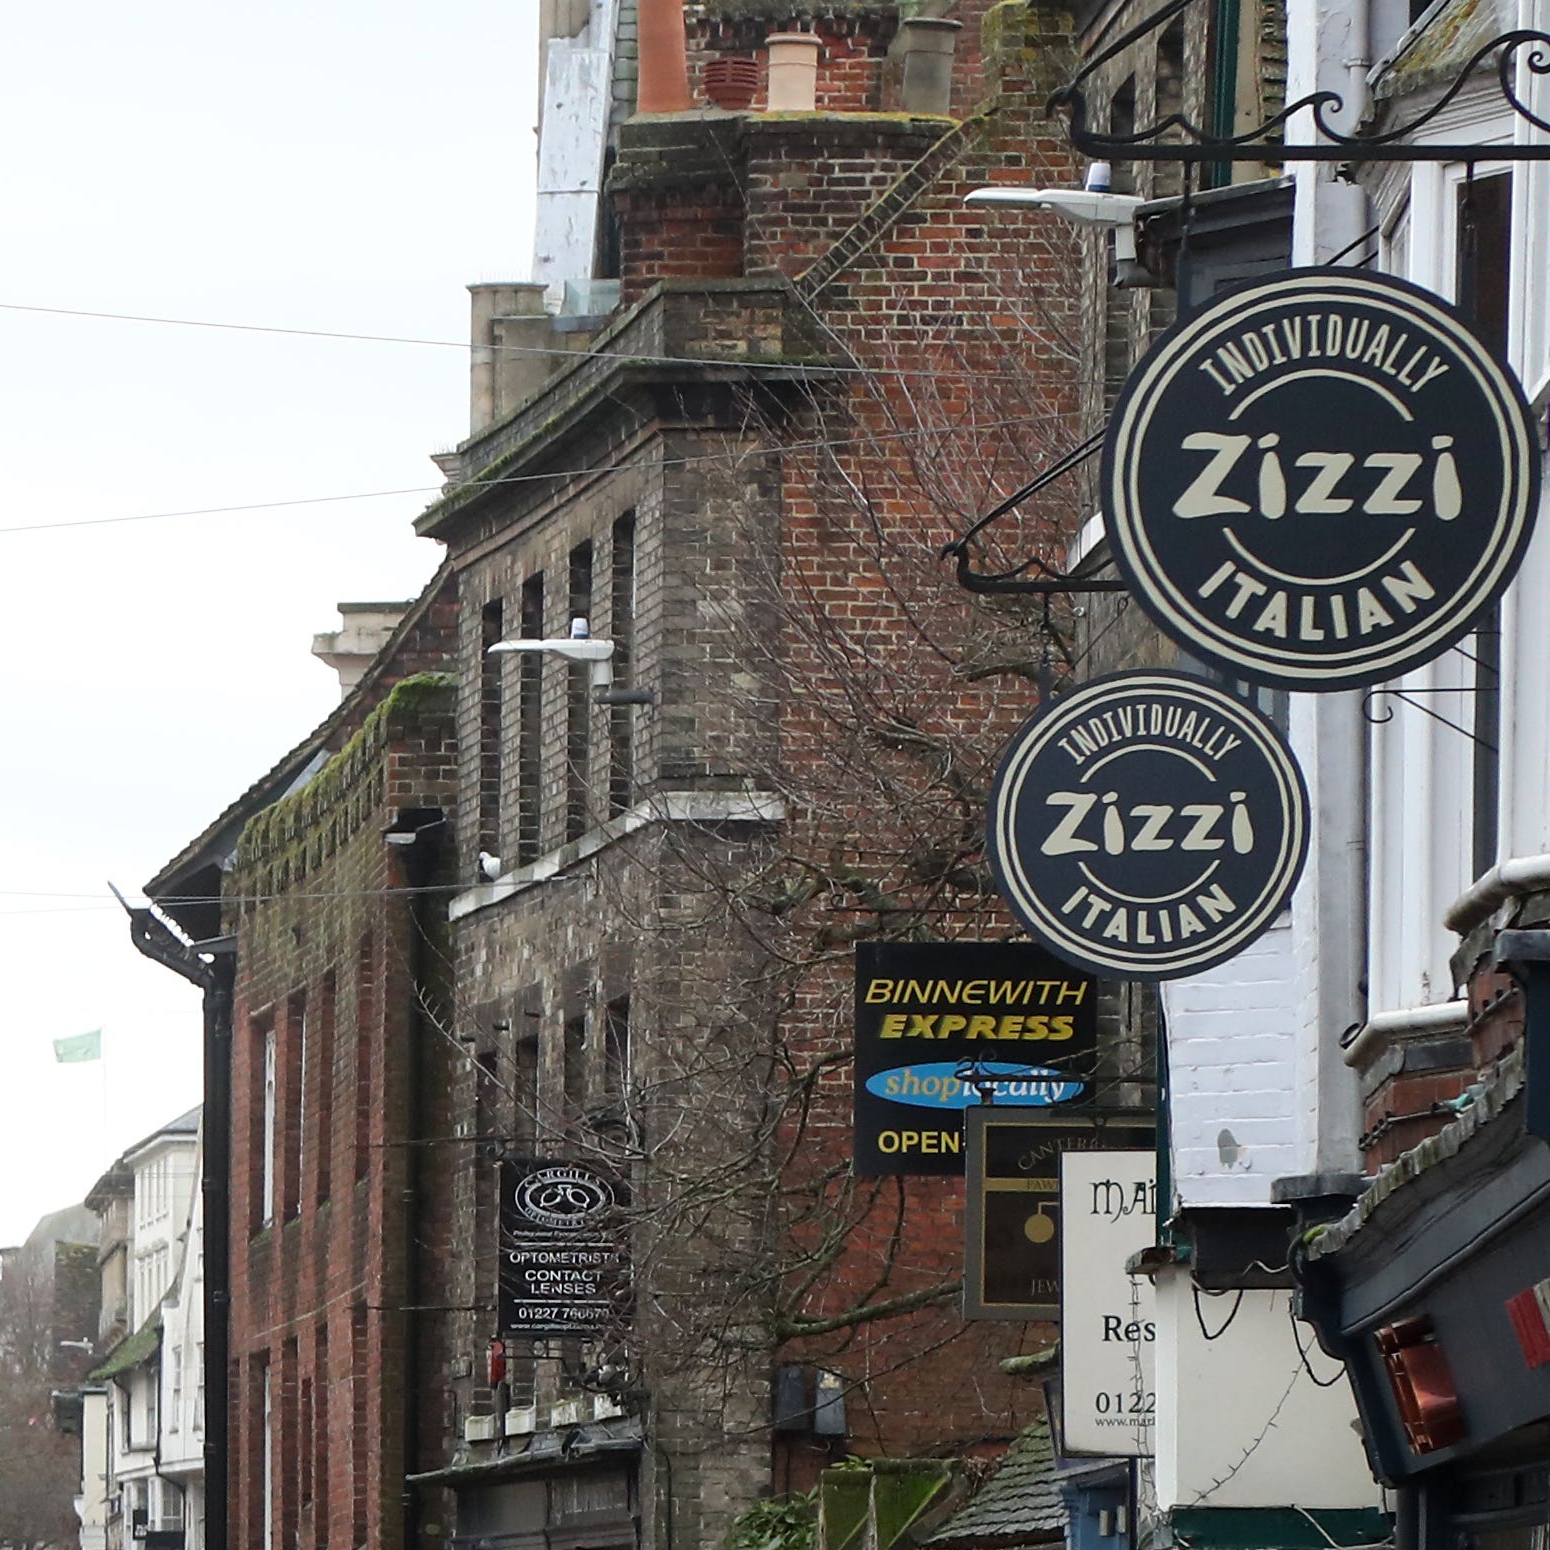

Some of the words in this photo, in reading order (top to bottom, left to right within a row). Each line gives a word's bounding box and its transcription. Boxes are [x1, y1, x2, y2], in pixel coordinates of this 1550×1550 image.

[1199, 312, 1450, 396] INDIVIDUALLY
[1172, 431, 1464, 521] Zizzi
[1198, 559, 1436, 642] ITALIAN
[1057, 703, 1242, 766] INDIVIDUALLY
[1040, 790, 1255, 856] Zizzi
[1061, 883, 1237, 944] ITALIAN
[864, 978, 1088, 1006] BINNEWITH
[879, 1013, 1075, 1041] EXPRESS
[878, 1130, 960, 1154] OPEN
[525, 1269, 604, 1282] CONTACT
[530, 1282, 597, 1295] LENSES
[518, 1307, 560, 1320] 01227
